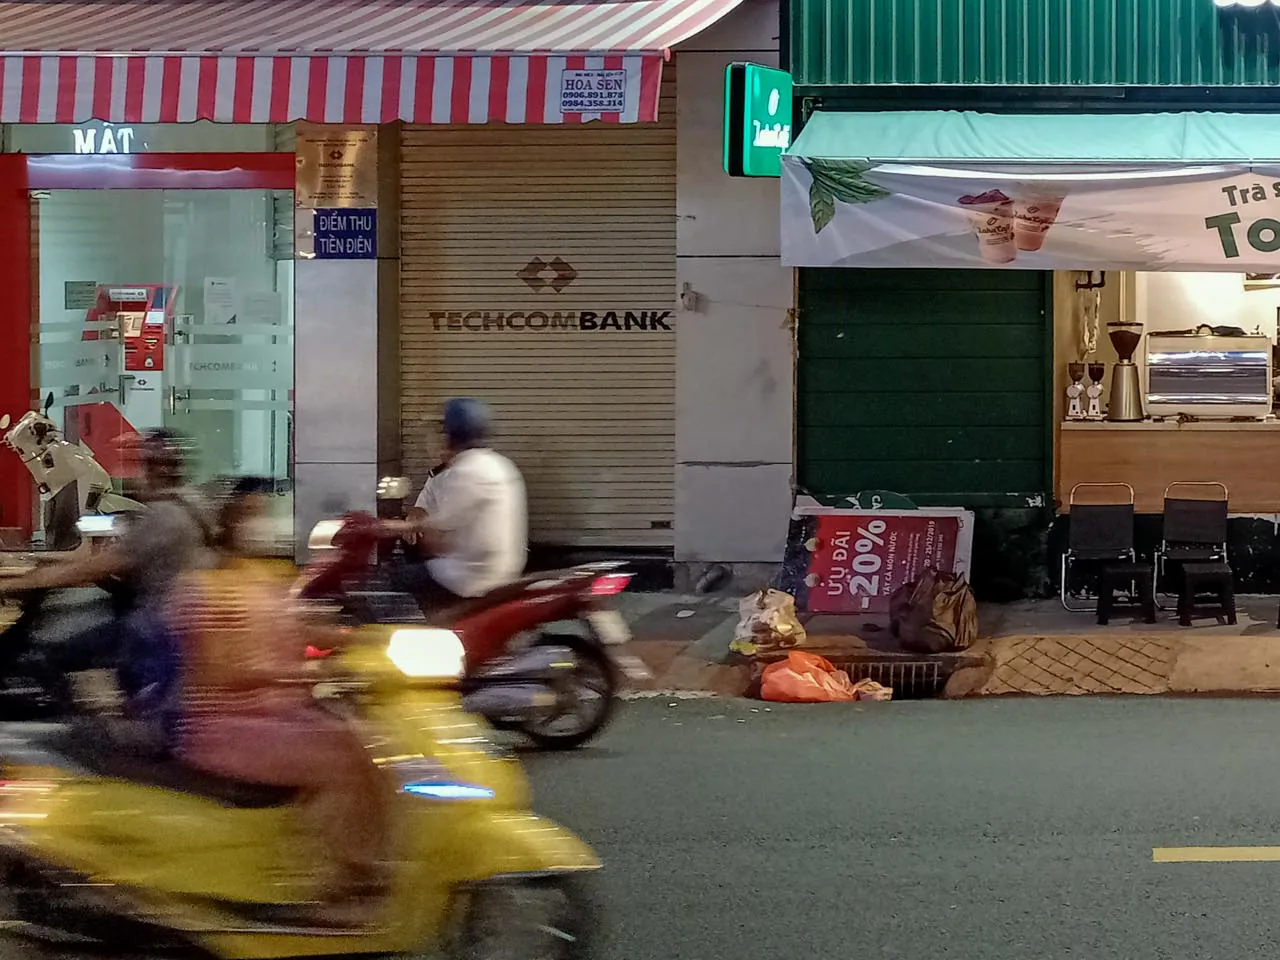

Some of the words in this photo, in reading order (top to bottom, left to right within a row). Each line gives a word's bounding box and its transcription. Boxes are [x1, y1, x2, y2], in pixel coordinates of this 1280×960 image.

[565, 80, 593, 90] HOA
[597, 80, 623, 90] SEN
[1222, 183, 1266, 206] Trà
[320, 211, 347, 231] ĐIỂM
[349, 216, 372, 231] THU
[320, 234, 344, 253] TIỀN
[346, 235, 372, 256] ĐIỆN
[429, 311, 672, 331] TECHCOMBANK
[831, 531, 851, 562] ĐÃI
